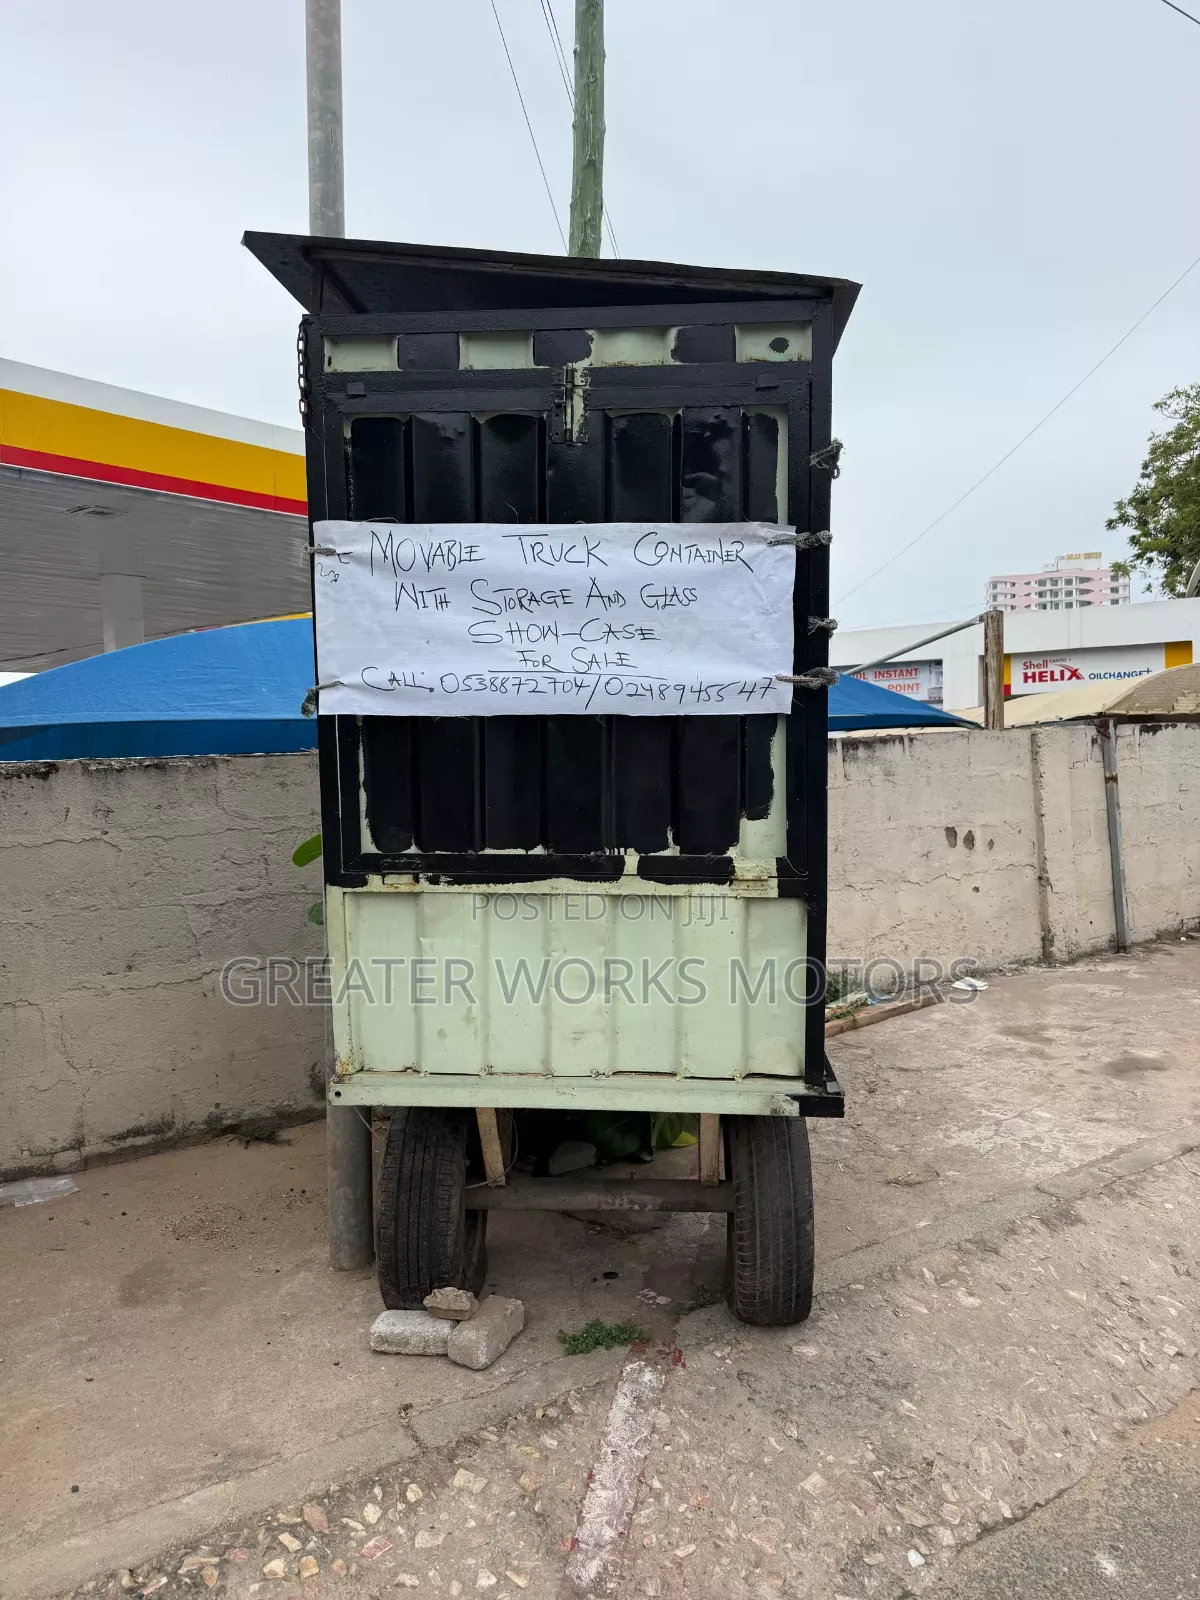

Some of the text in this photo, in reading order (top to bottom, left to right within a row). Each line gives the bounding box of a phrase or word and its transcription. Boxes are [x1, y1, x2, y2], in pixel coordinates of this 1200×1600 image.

[370, 530, 754, 577] MOVABLE TRUCK CONTAINER
[395, 576, 698, 615] WITH STORAGE AND GLASS
[468, 617, 661, 645] SHOW-CASE
[516, 646, 638, 674] FOR SALE
[874, 667, 920, 680] INSTANT
[1022, 660, 1048, 670] Shell
[1022, 668, 1085, 684] HELIX
